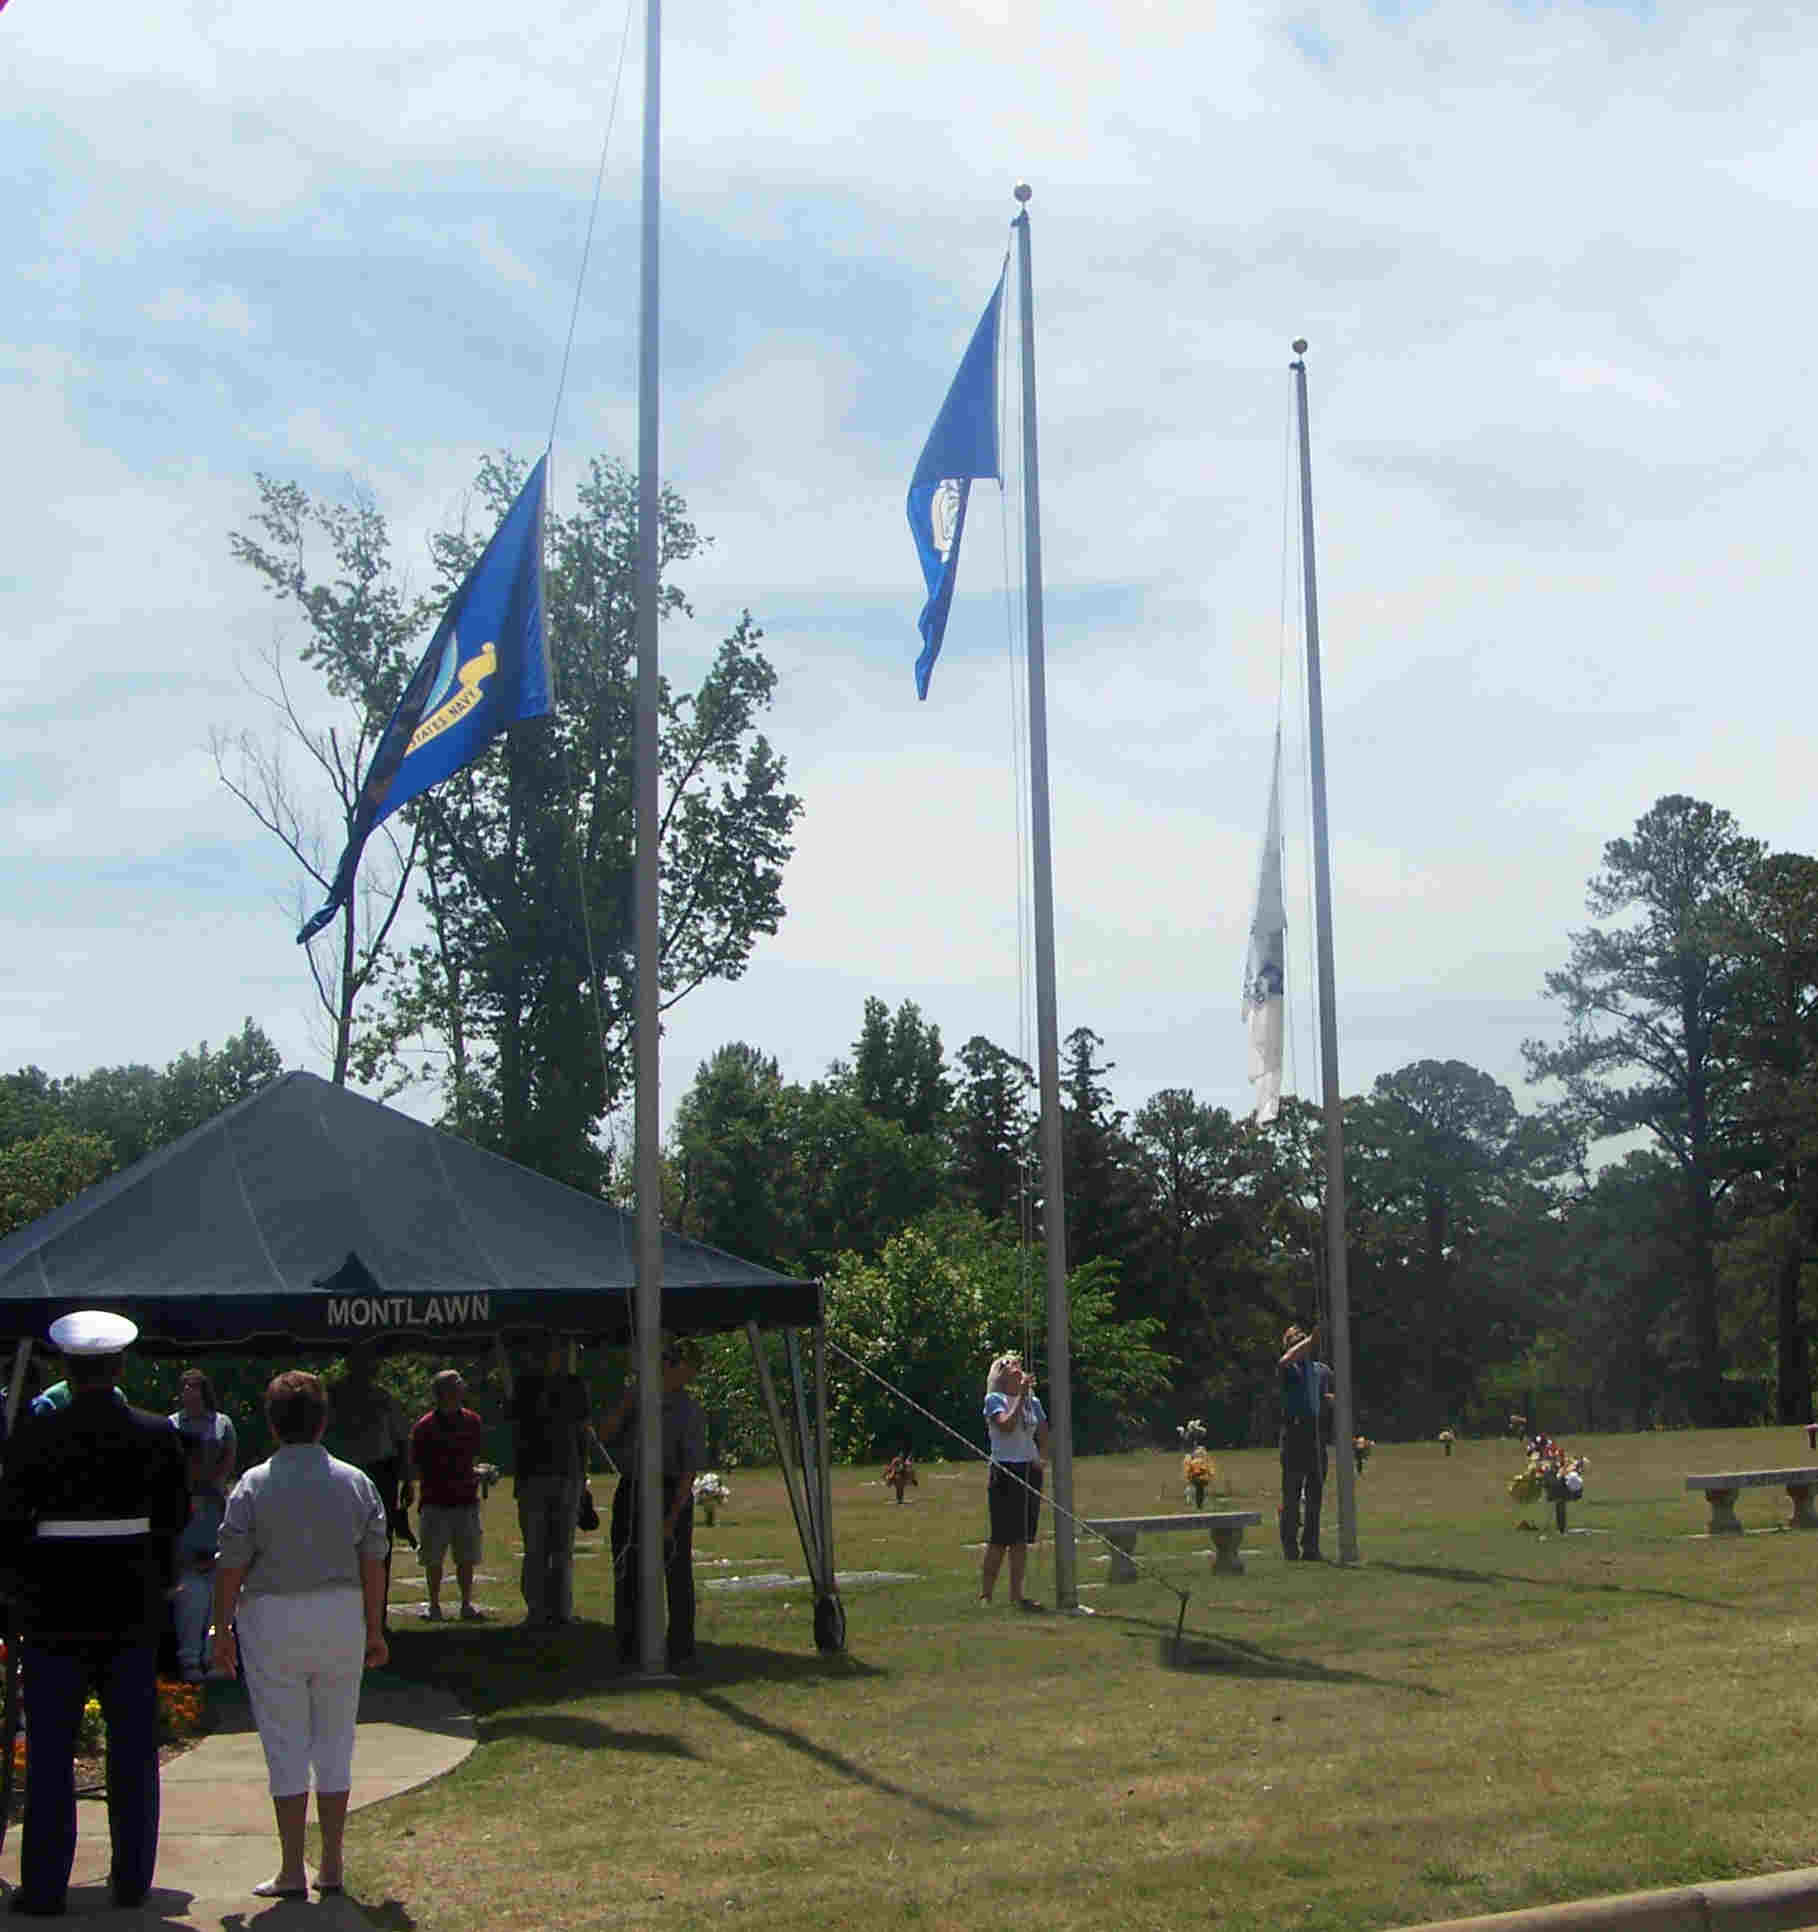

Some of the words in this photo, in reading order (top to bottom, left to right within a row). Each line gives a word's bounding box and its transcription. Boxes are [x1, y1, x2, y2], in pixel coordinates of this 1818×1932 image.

[413, 716, 448, 745] TATES
[448, 688, 476, 717] NAVY
[327, 1296, 490, 1326] MONTLAWN
